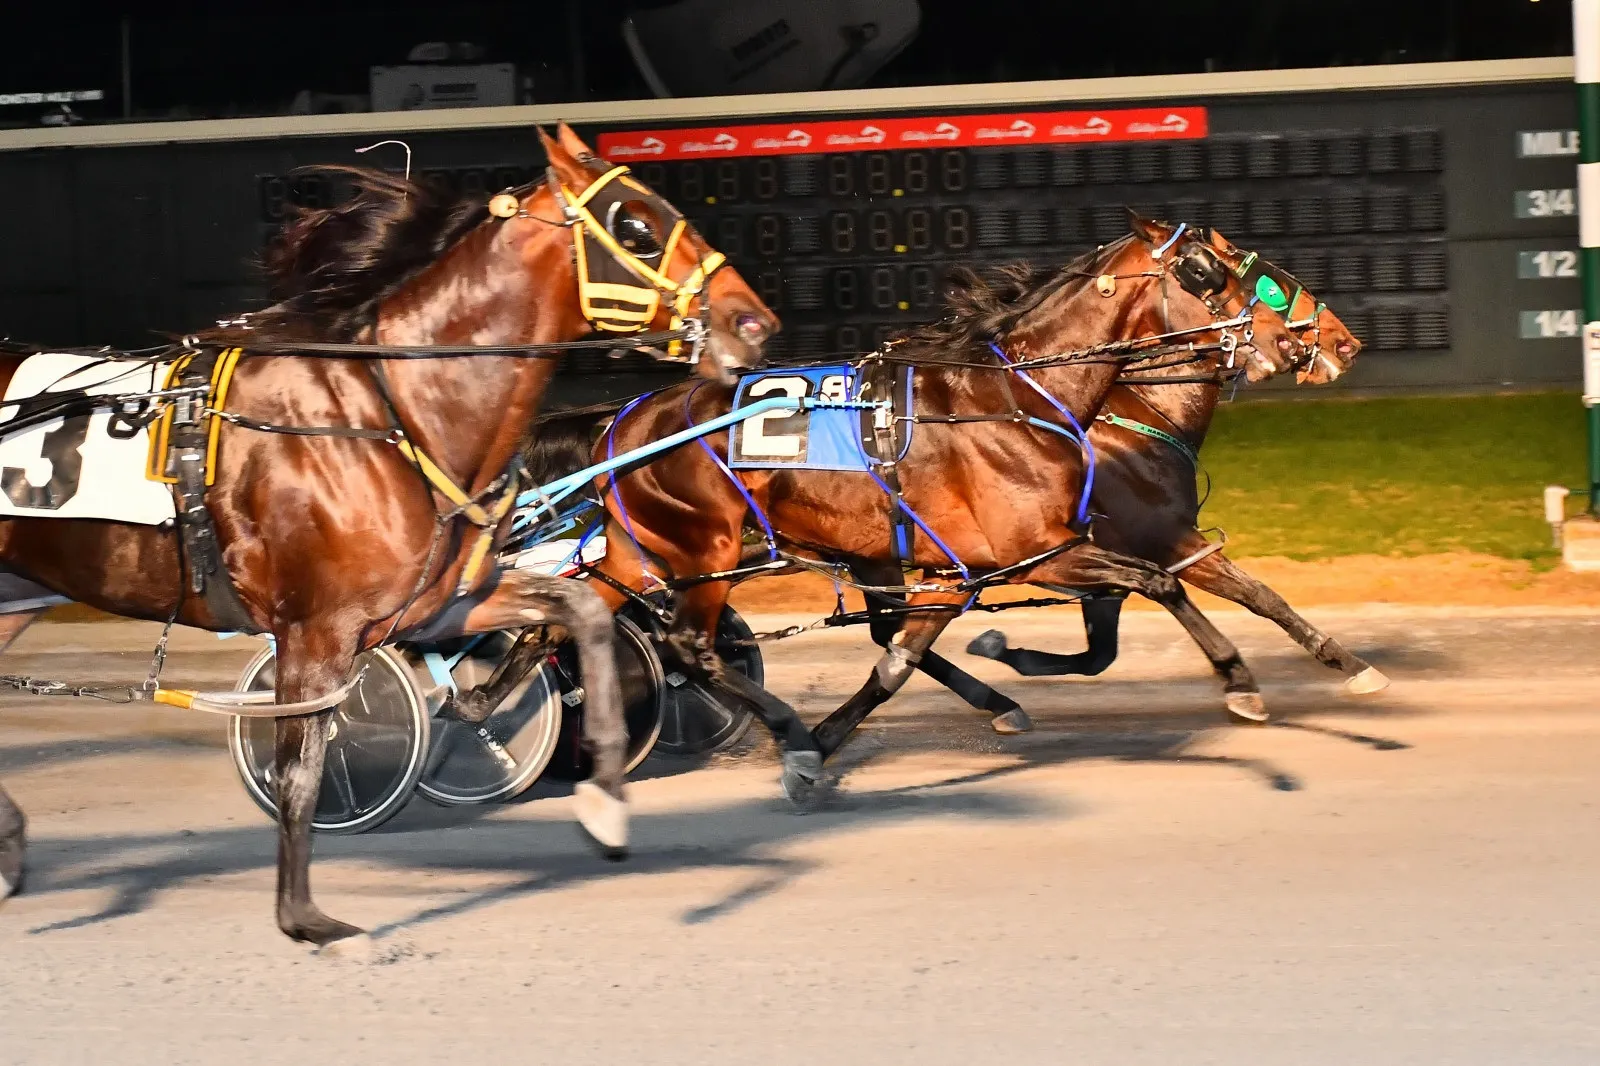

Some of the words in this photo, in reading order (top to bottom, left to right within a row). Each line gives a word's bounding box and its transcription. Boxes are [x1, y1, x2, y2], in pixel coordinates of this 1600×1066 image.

[1527, 188, 1576, 216] 3/4
[1532, 250, 1578, 278] 1/2
[1534, 309, 1579, 338] 1/4
[739, 375, 809, 457] 2
[0, 390, 92, 510] 3
